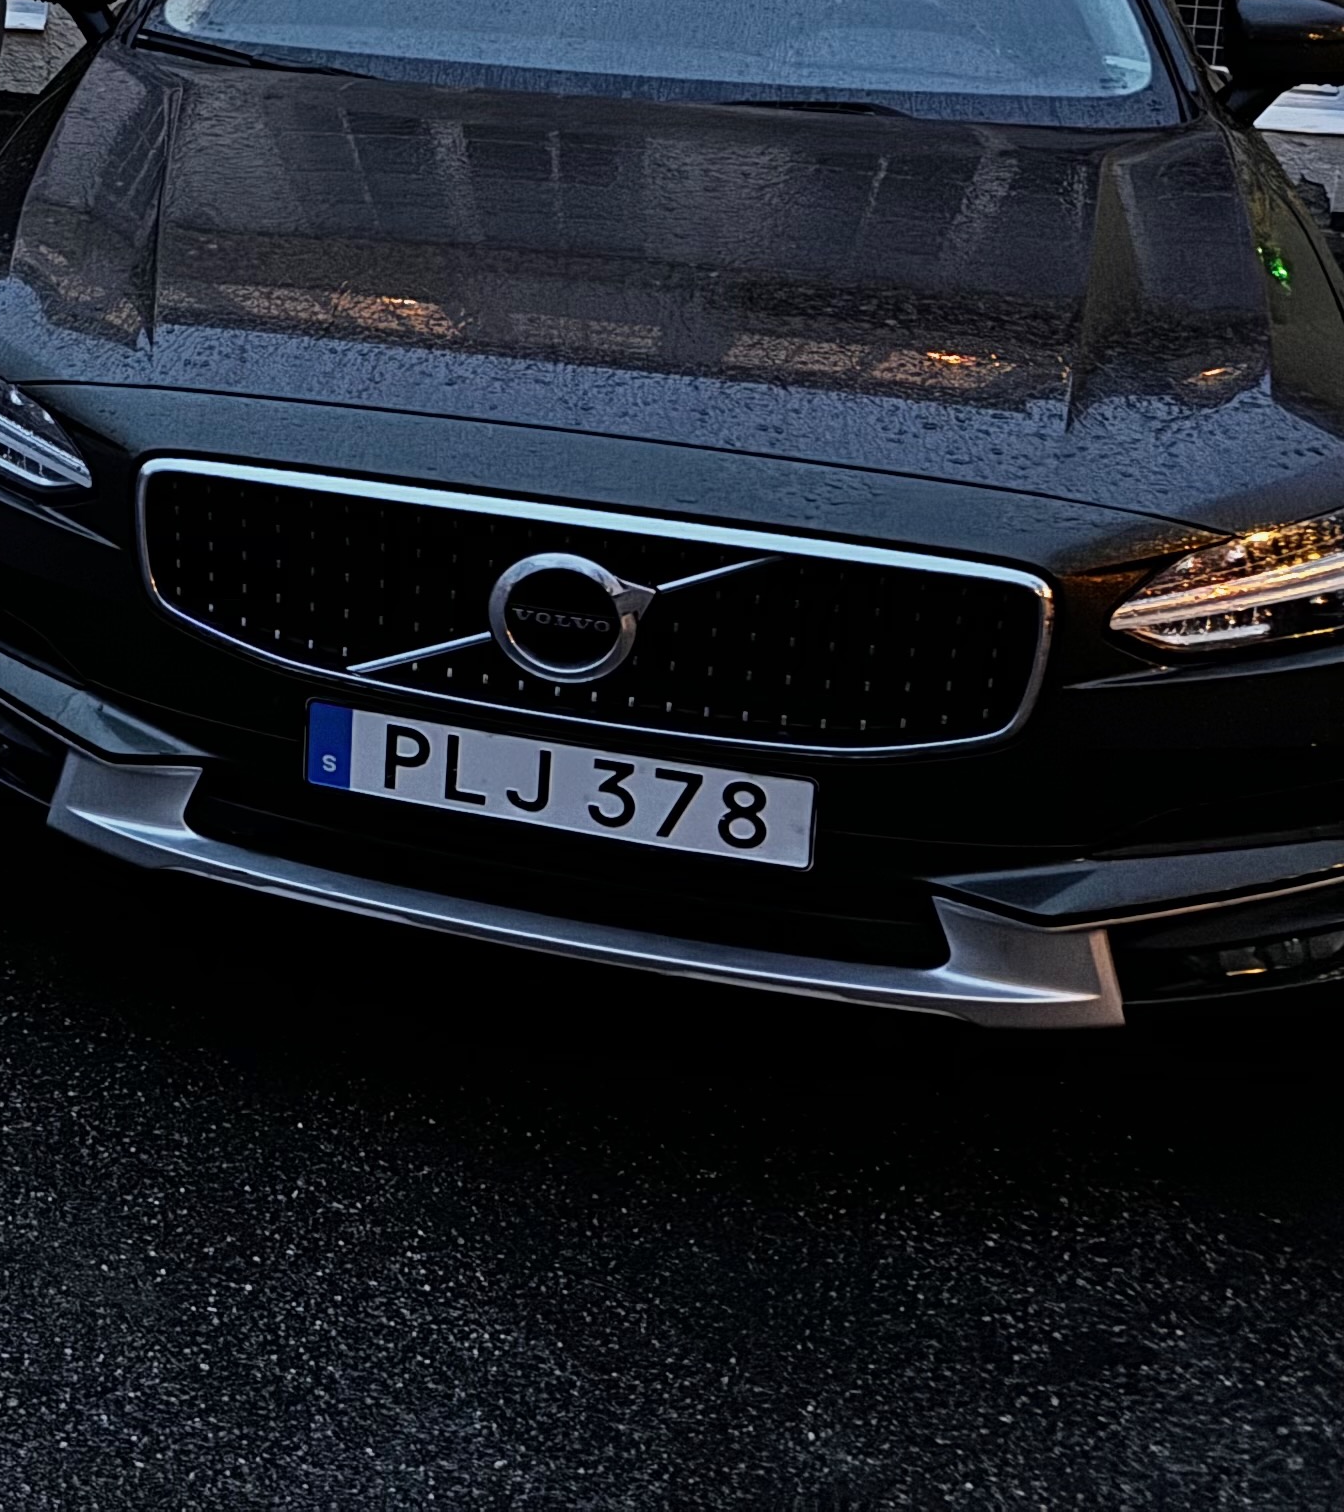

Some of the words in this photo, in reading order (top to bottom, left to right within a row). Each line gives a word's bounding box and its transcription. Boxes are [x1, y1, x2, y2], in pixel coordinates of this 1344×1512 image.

[512, 607, 610, 633] VOLVO
[321, 753, 337, 773] S
[383, 723, 552, 813] PLJ
[587, 757, 768, 850] 378
